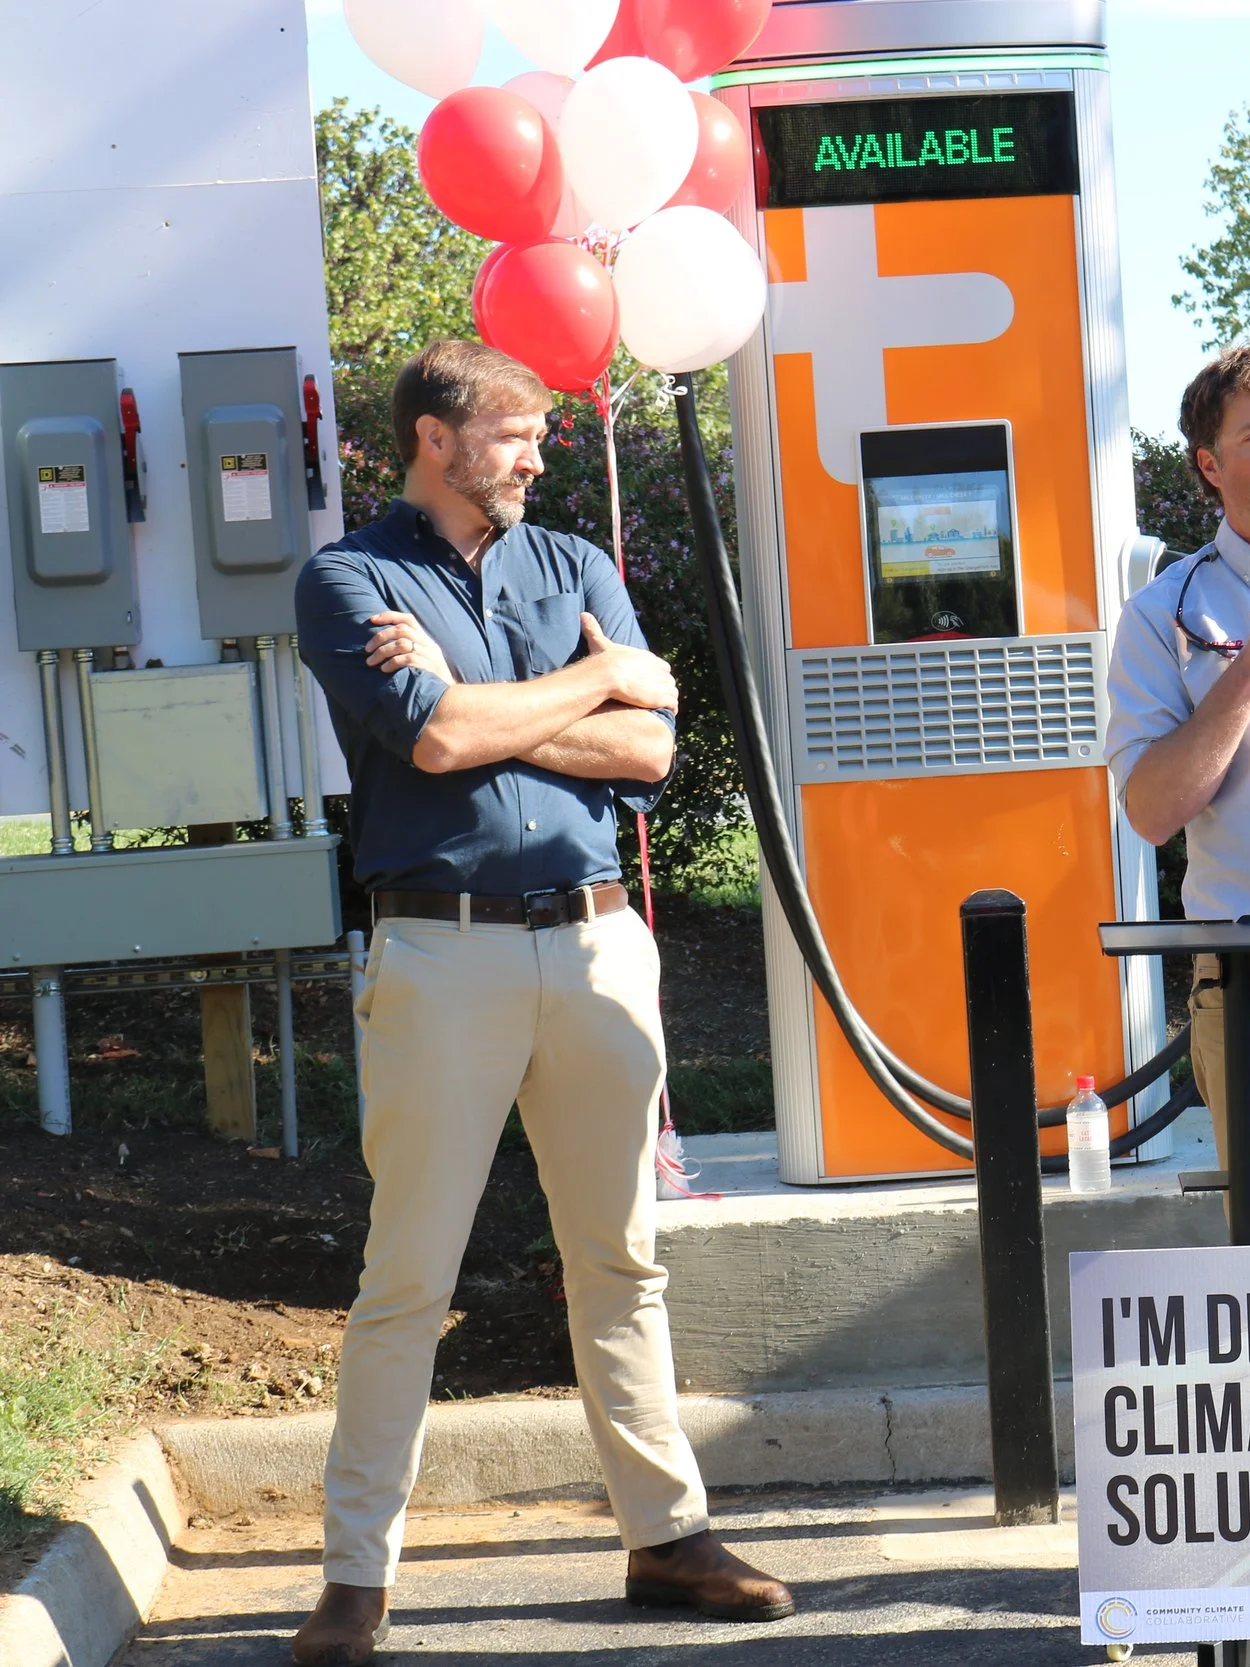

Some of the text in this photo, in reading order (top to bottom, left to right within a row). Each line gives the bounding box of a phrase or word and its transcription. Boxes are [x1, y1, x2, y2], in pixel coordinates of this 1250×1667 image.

[814, 127, 1015, 171] AVAILABLE
[1102, 1295, 1186, 1367] I'M
[1146, 1605, 1245, 1615] COMMUNITY CLIMATE
[1146, 1615, 1245, 1625] COLLABORATIVE
